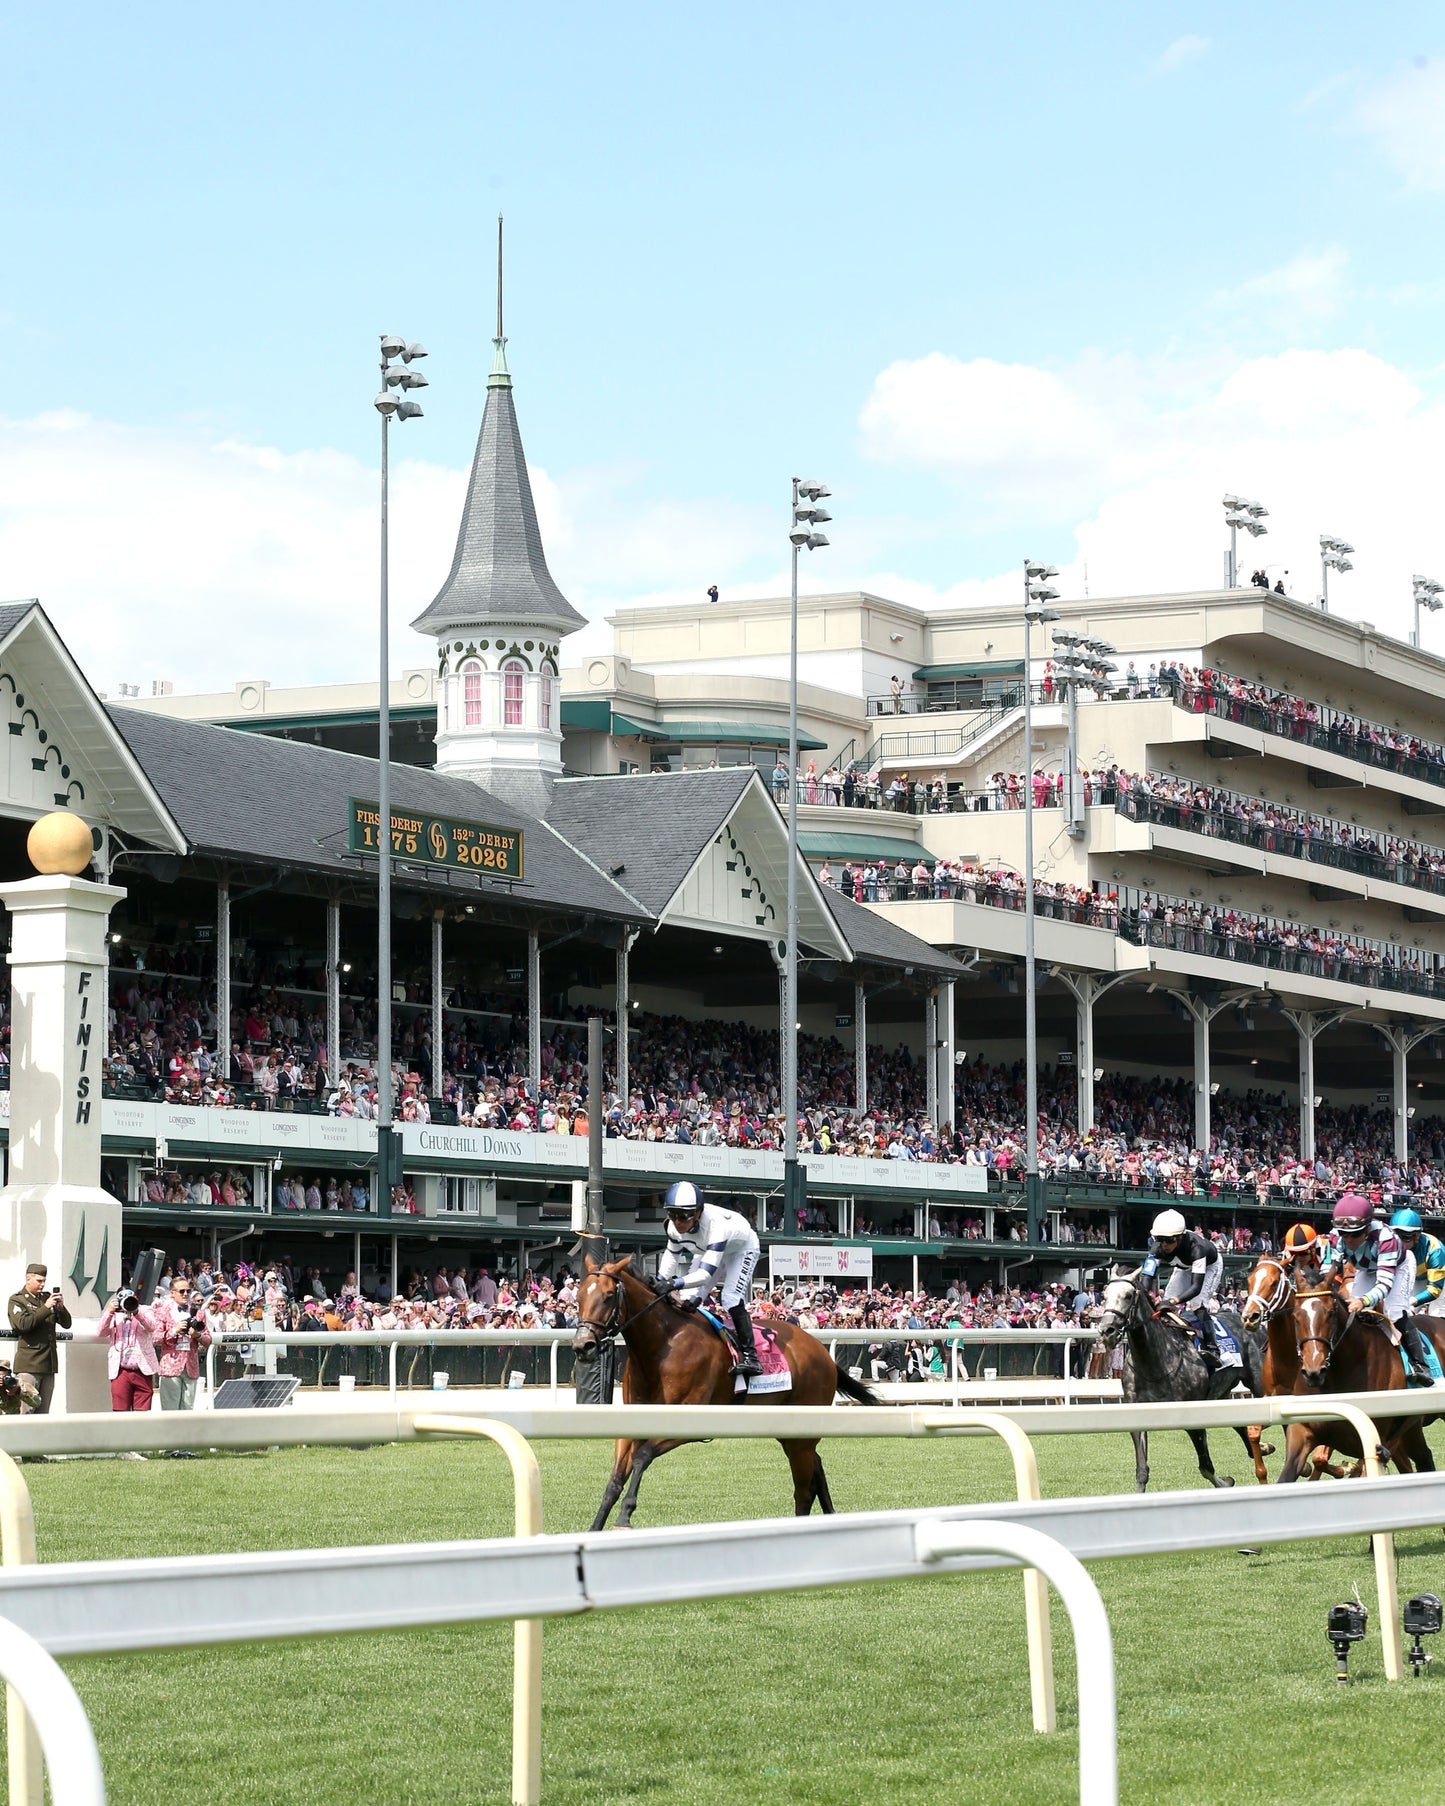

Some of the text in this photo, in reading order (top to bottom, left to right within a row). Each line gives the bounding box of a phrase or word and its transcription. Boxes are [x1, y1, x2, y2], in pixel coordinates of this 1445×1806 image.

[357, 810, 423, 833] FIRS DERBY
[478, 832, 515, 850] DERBY
[456, 844, 508, 870] 2026
[76, 971, 92, 1125] FINISH
[113, 1110, 145, 1119] WOODFORD
[168, 1115, 197, 1126] LONGINES
[117, 1120, 143, 1128] RESERVE
[220, 1118, 250, 1127] WOODFORD
[272, 1123, 298, 1133] LONGINES
[223, 1127, 248, 1136] RESERVE
[419, 1131, 522, 1156] CHURCHILL DOWNS
[1145, 1257, 1156, 1273] 3
